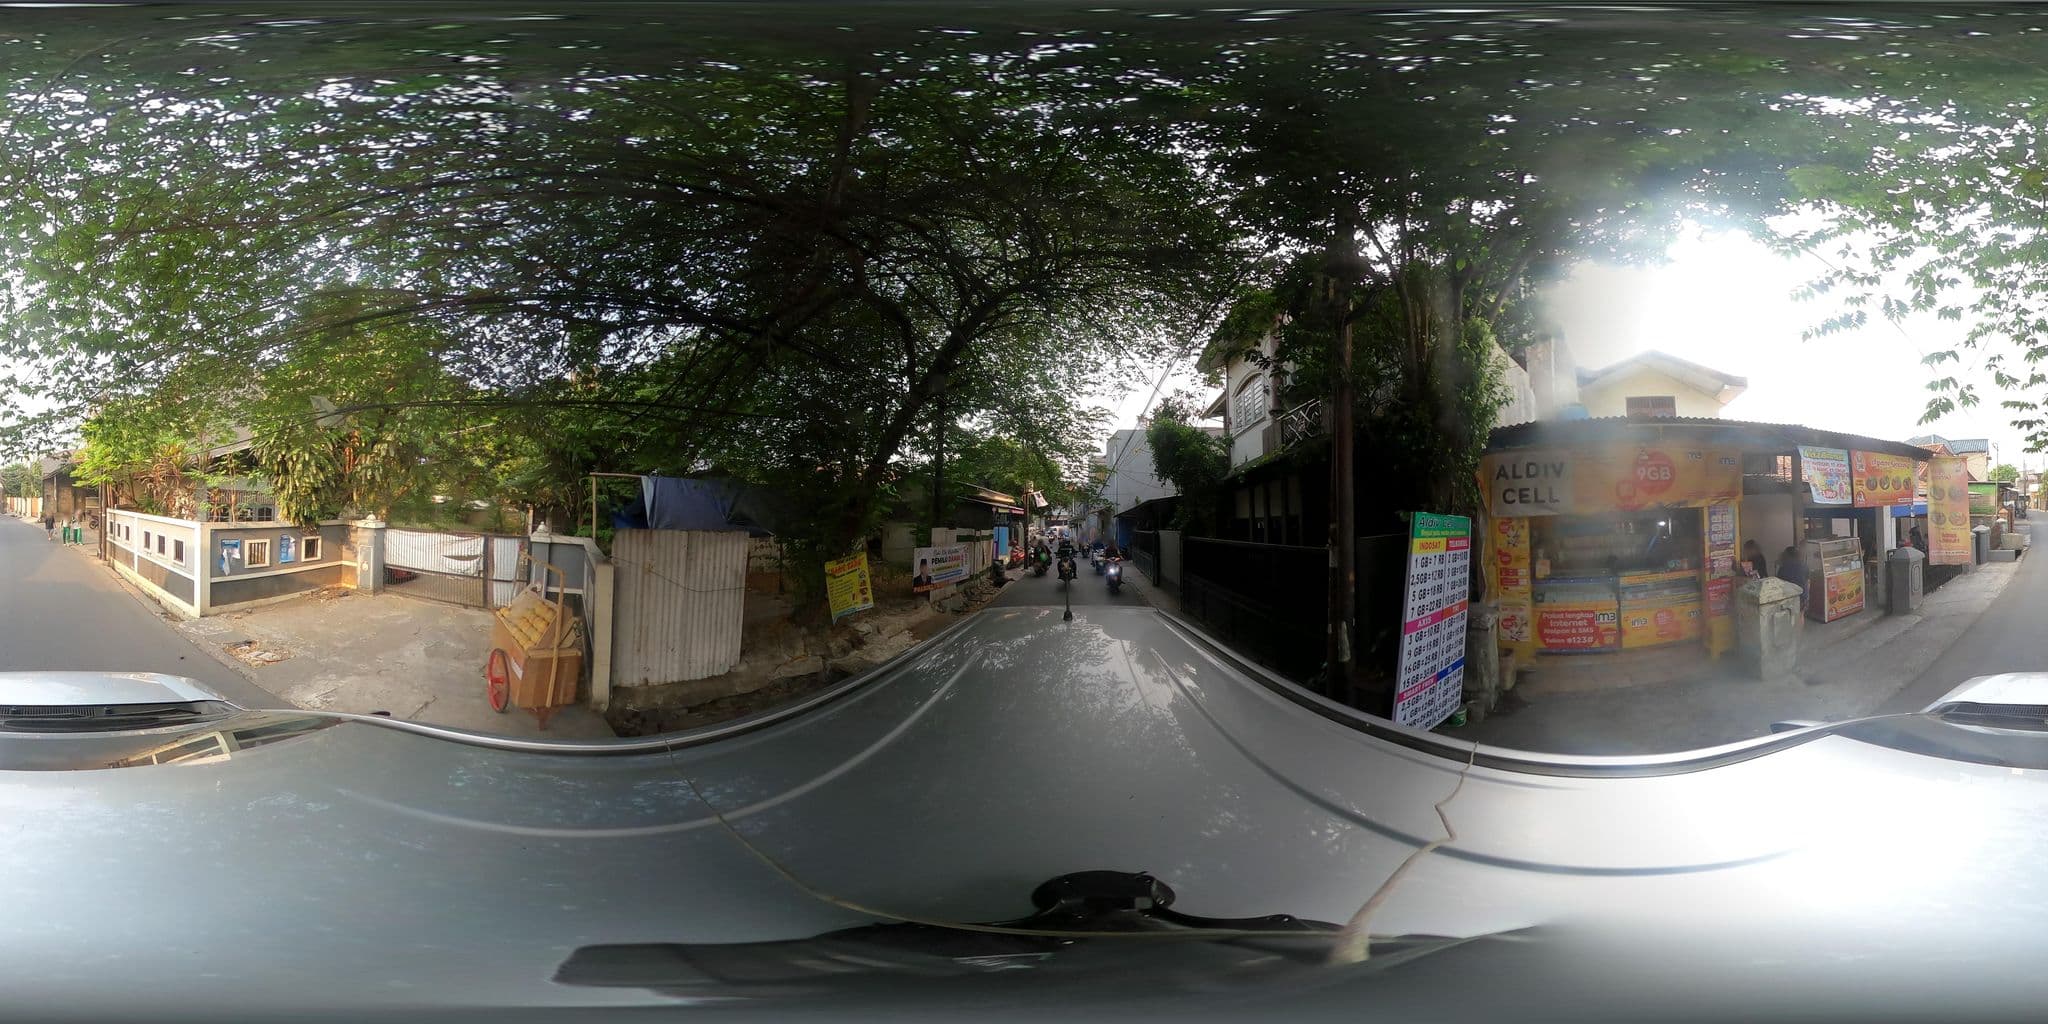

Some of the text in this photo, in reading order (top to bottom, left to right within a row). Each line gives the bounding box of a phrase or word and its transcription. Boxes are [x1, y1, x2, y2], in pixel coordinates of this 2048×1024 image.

[1496, 462, 1564, 480] ALDIV
[1636, 466, 1672, 481] 9GB
[1503, 486, 1560, 504] CELL
[1417, 616, 1432, 628] AXIS
[1550, 619, 1588, 627] Internet
[1595, 612, 1616, 621] im3
